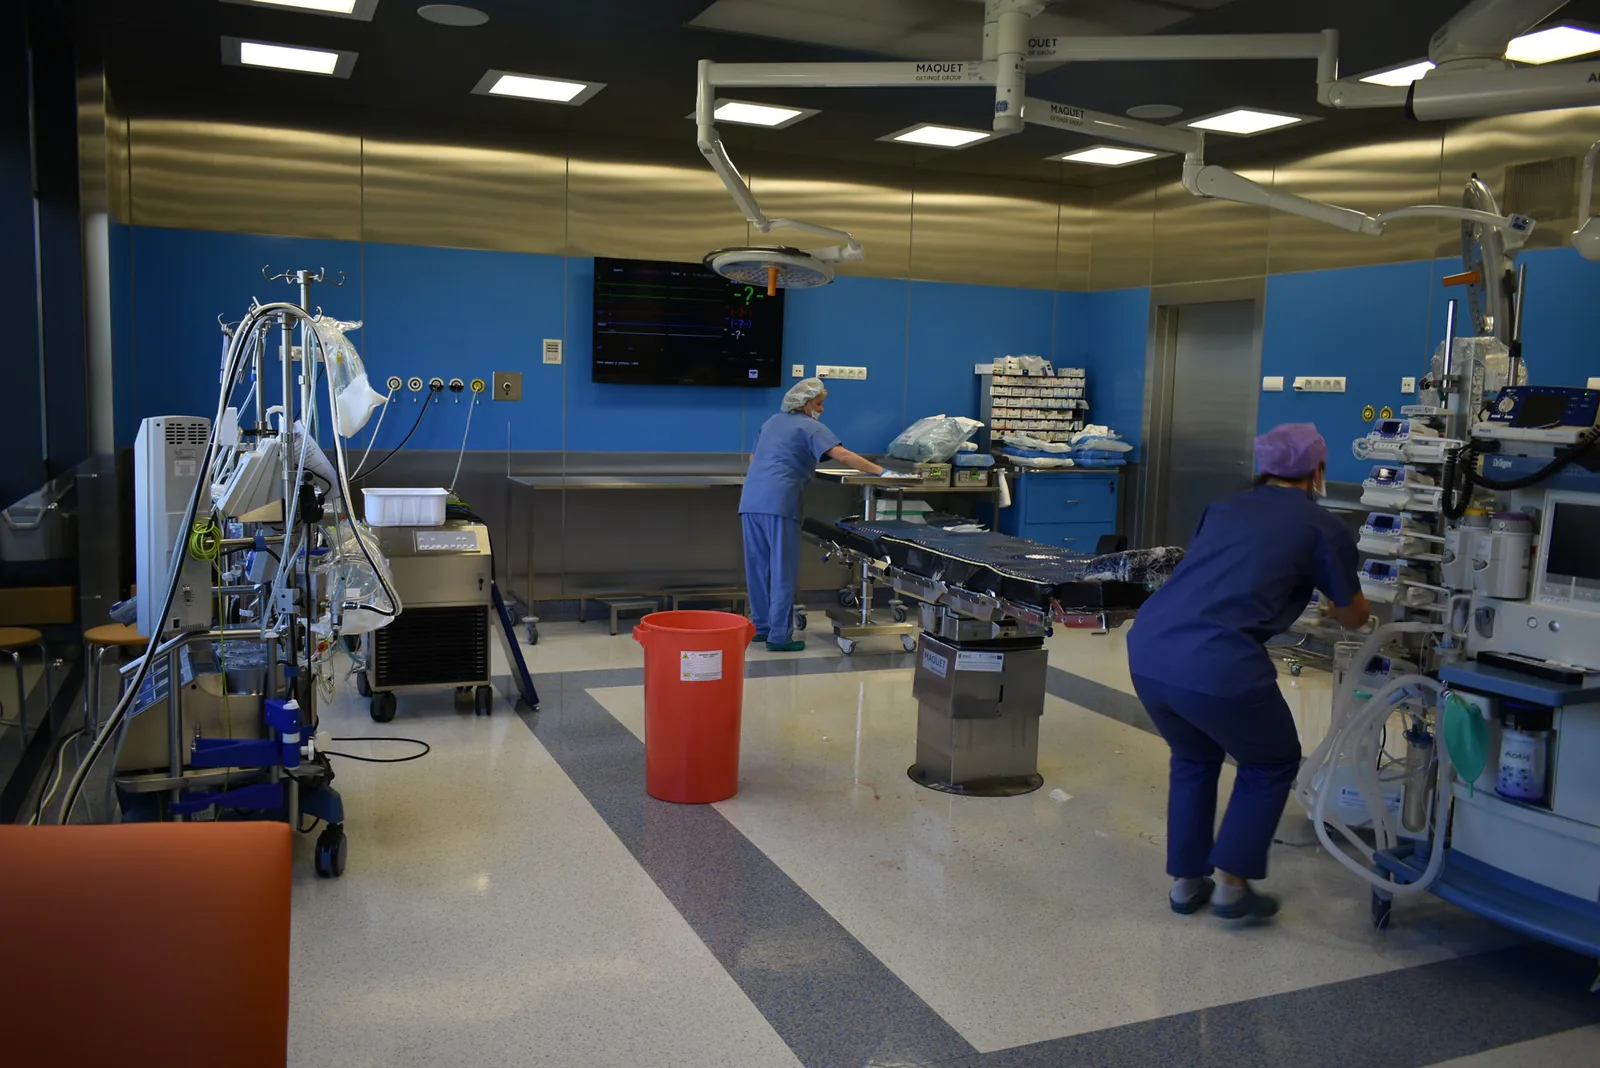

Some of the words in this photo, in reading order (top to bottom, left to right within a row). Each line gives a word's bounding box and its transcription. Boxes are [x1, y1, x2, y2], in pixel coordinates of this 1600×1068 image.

[1028, 38, 1058, 48] QUET
[916, 64, 963, 74] MAQUET
[1587, 72, 1600, 83] A
[1051, 104, 1085, 119] MAQUET
[924, 652, 946, 668] MAQUET
